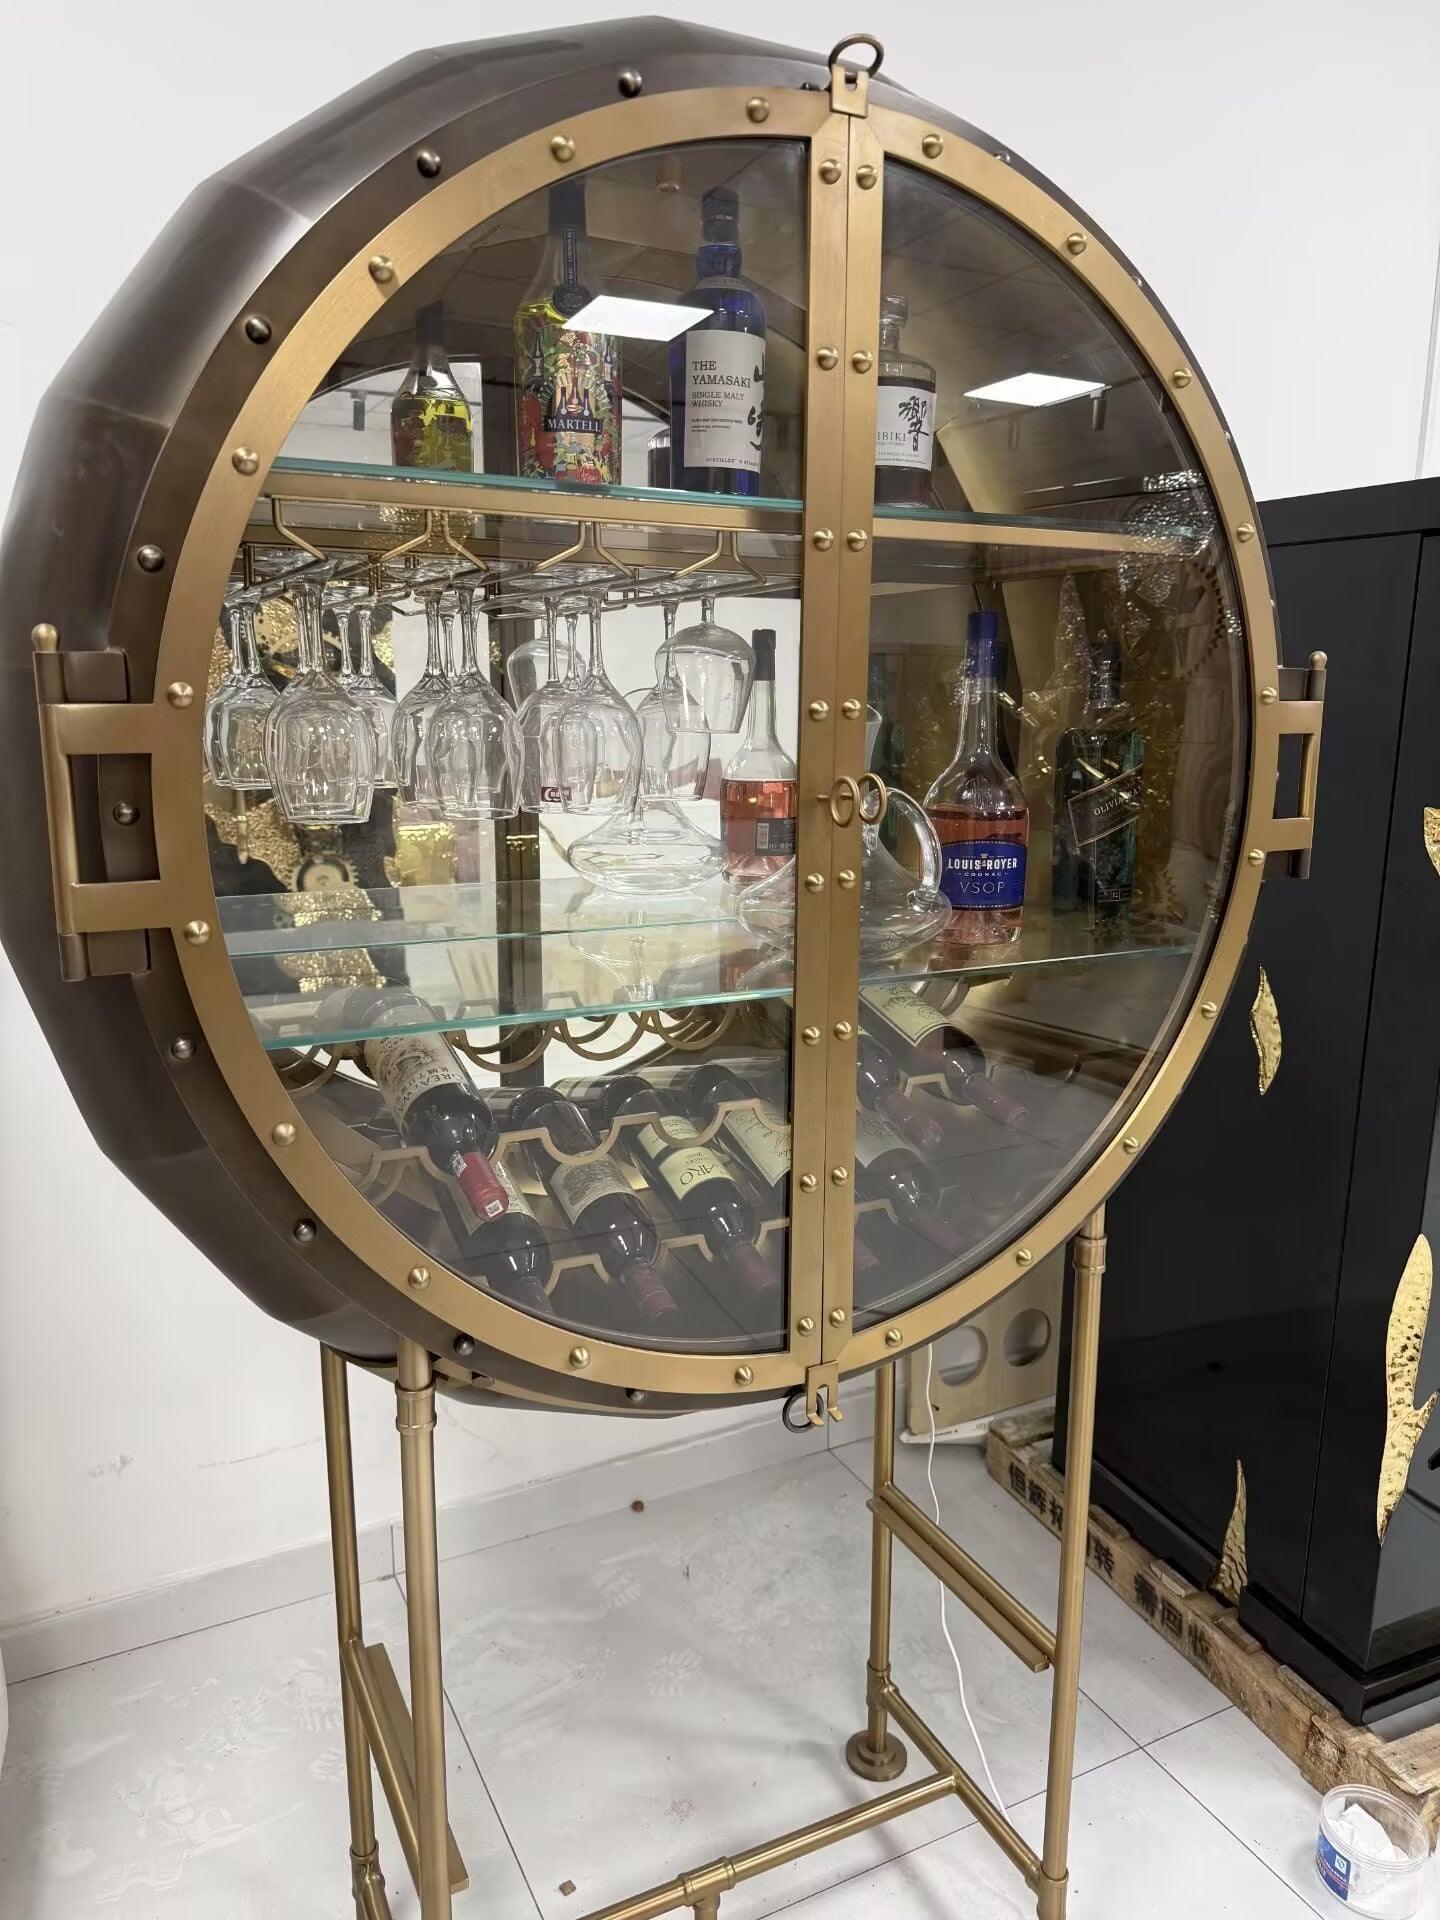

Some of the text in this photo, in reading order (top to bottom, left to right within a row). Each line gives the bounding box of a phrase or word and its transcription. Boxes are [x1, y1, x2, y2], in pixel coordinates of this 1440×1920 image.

[693, 361, 717, 371] THE
[693, 375, 751, 389] YAMASAKI
[724, 393, 745, 401] MALT
[692, 400, 722, 408] WHISKY
[547, 418, 601, 432] MARTELL
[876, 431, 907, 442] IBIKI
[948, 857, 1019, 870] LOUIS ROYER
[960, 881, 1006, 894] VSOP
[415, 1073, 464, 1090] GREA
